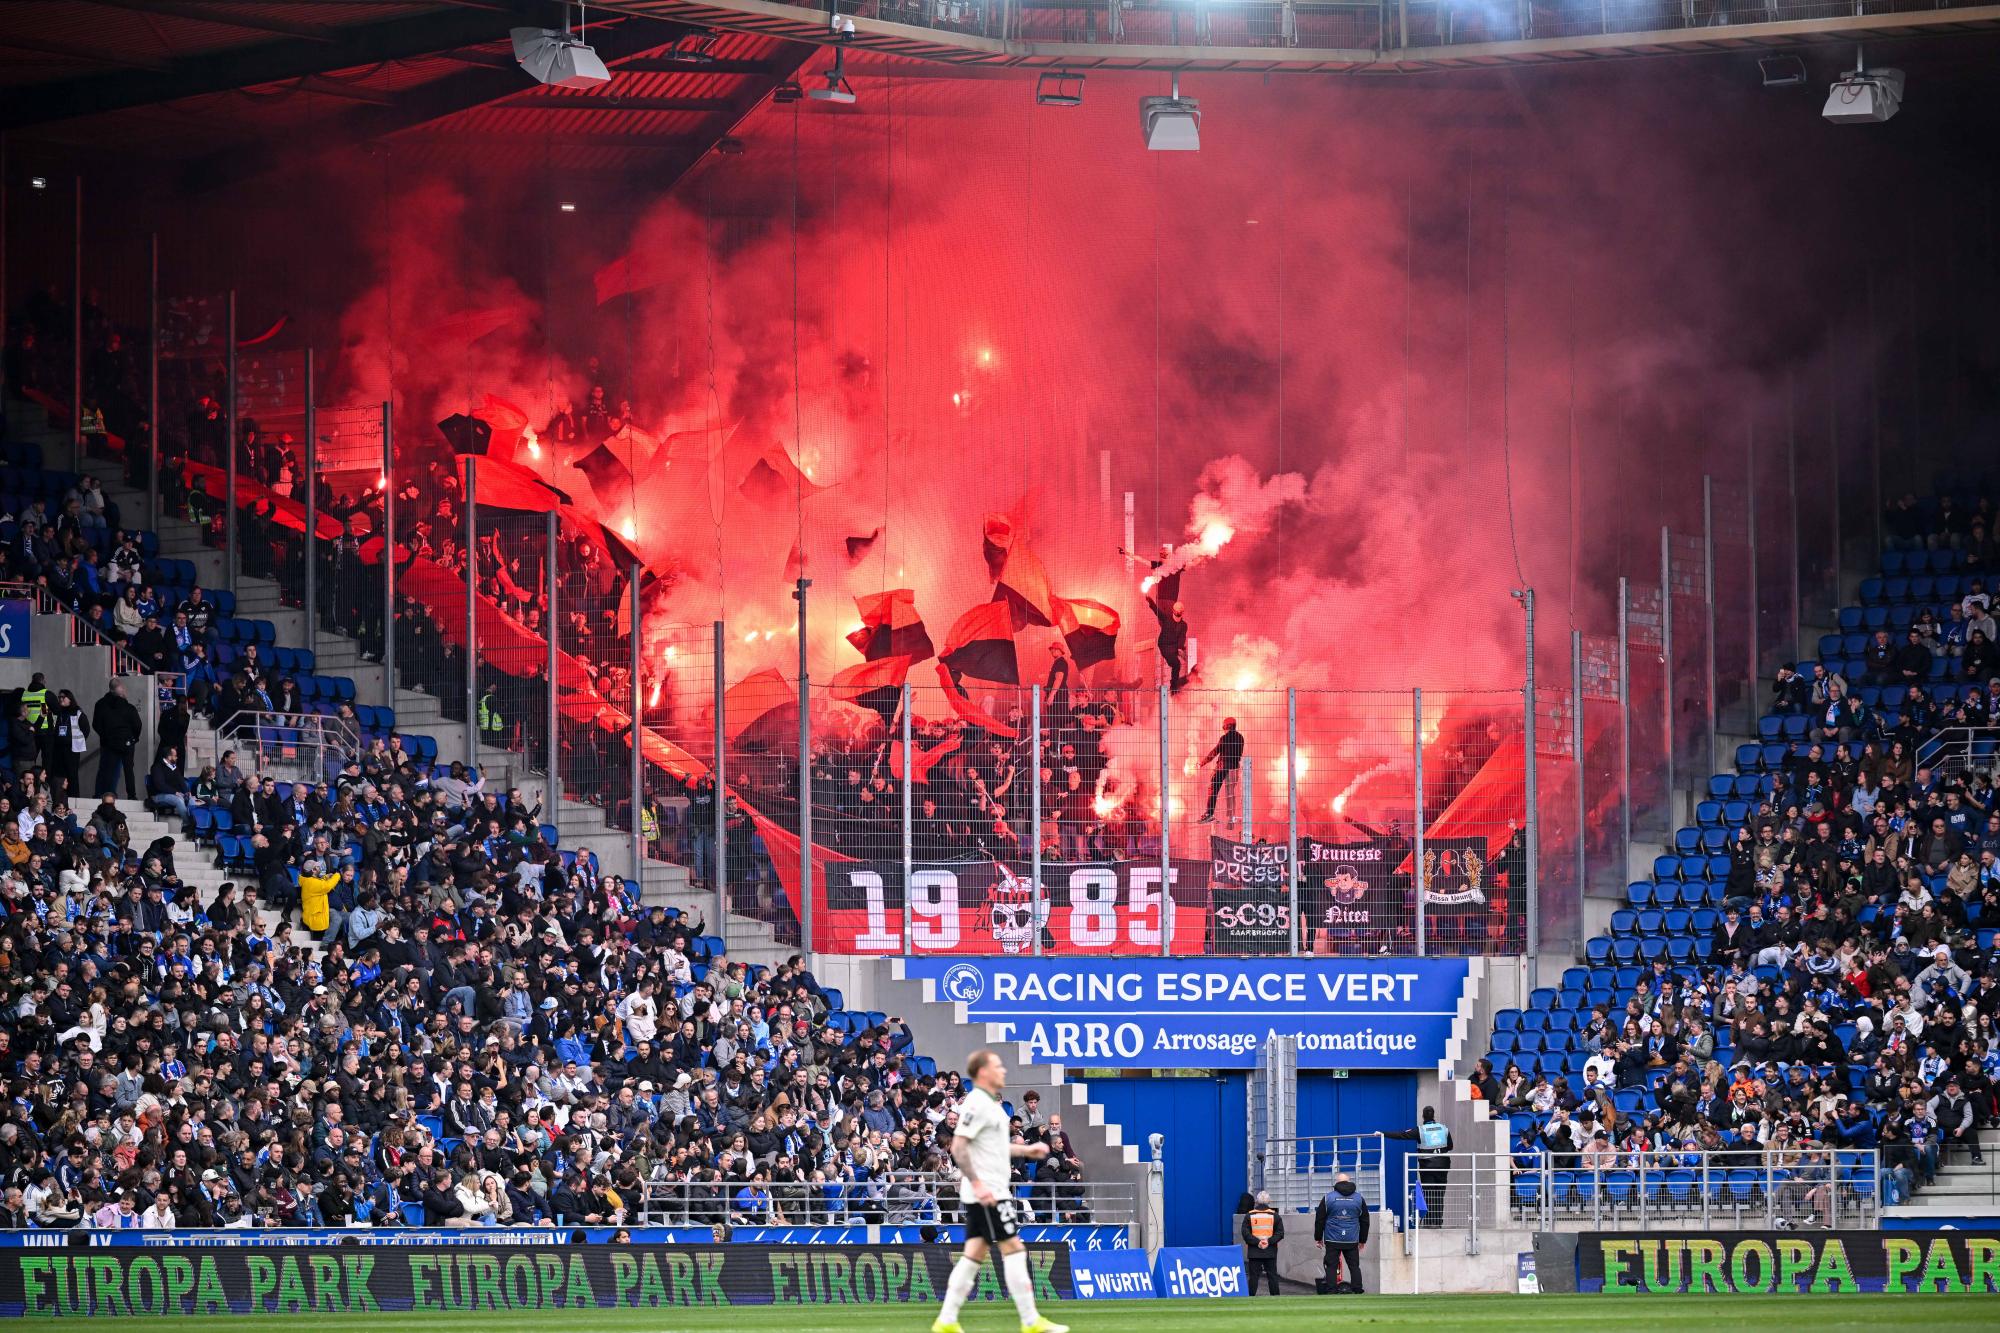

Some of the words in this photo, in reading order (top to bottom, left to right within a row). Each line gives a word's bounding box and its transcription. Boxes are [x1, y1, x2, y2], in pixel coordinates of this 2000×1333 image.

[1233, 845, 1287, 864] ENZO
[1310, 843, 1382, 862] Jeunesse
[1215, 903, 1290, 929] SC95
[1323, 904, 1370, 924] Nicea
[994, 973, 1143, 1001] RACING
[1158, 973, 1307, 1001] ESPACE
[1318, 973, 1418, 1001] VERT
[1031, 1021, 1144, 1058] ARRO
[1154, 1028, 1256, 1055] Arrosage
[1263, 1028, 1417, 1055] Atomatique
[1600, 1239, 1860, 1293] EUROPA
[20, 1256, 231, 1317] EUROPA
[245, 1255, 380, 1314] PARK
[408, 1253, 598, 1311] EUROPA
[611, 1252, 731, 1308] PARK
[769, 1252, 935, 1305] EUROPA
[950, 1250, 1061, 1302] AK
[1094, 1271, 1153, 1293] WÜRTH
